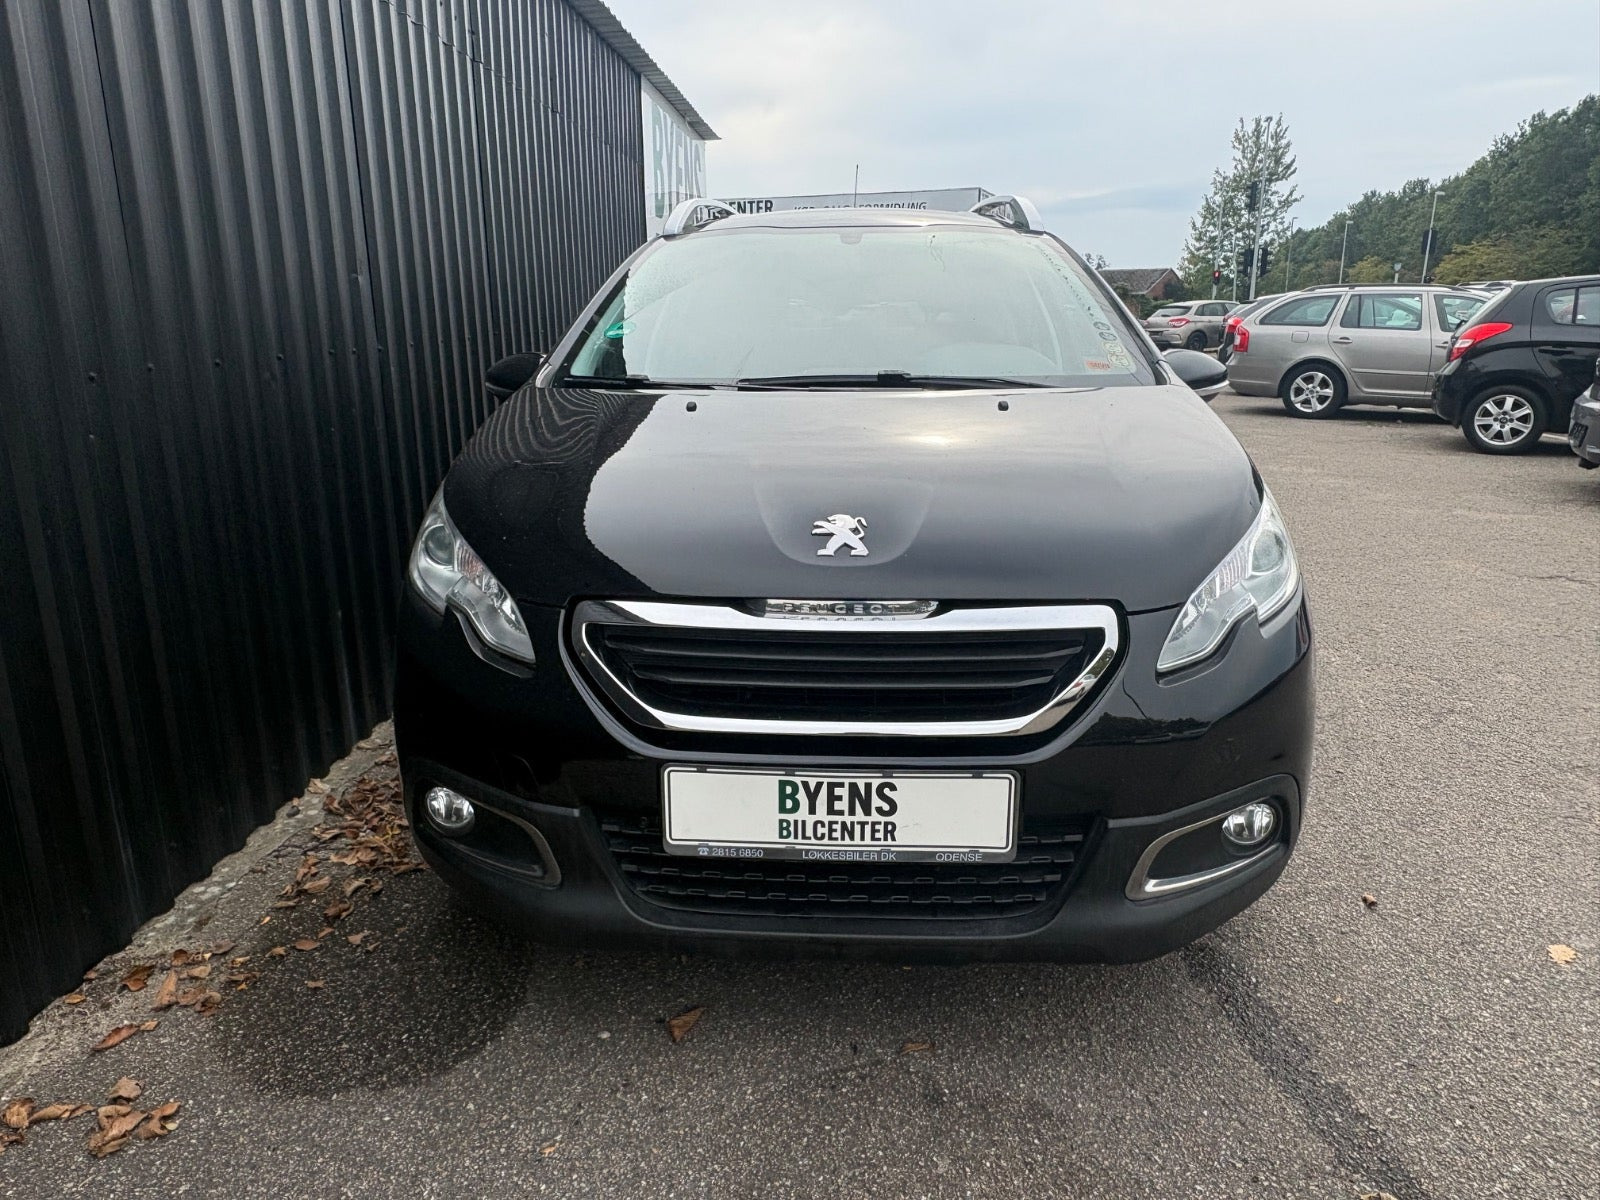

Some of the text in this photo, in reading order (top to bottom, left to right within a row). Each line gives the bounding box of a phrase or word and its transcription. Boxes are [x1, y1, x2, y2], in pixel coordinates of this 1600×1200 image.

[778, 779, 898, 817] BYENS
[778, 819, 897, 841] BILCENTER
[711, 847, 764, 858] 2815 6850
[802, 850, 877, 861] LØKKESBILER
[935, 853, 983, 862] ODENSE
